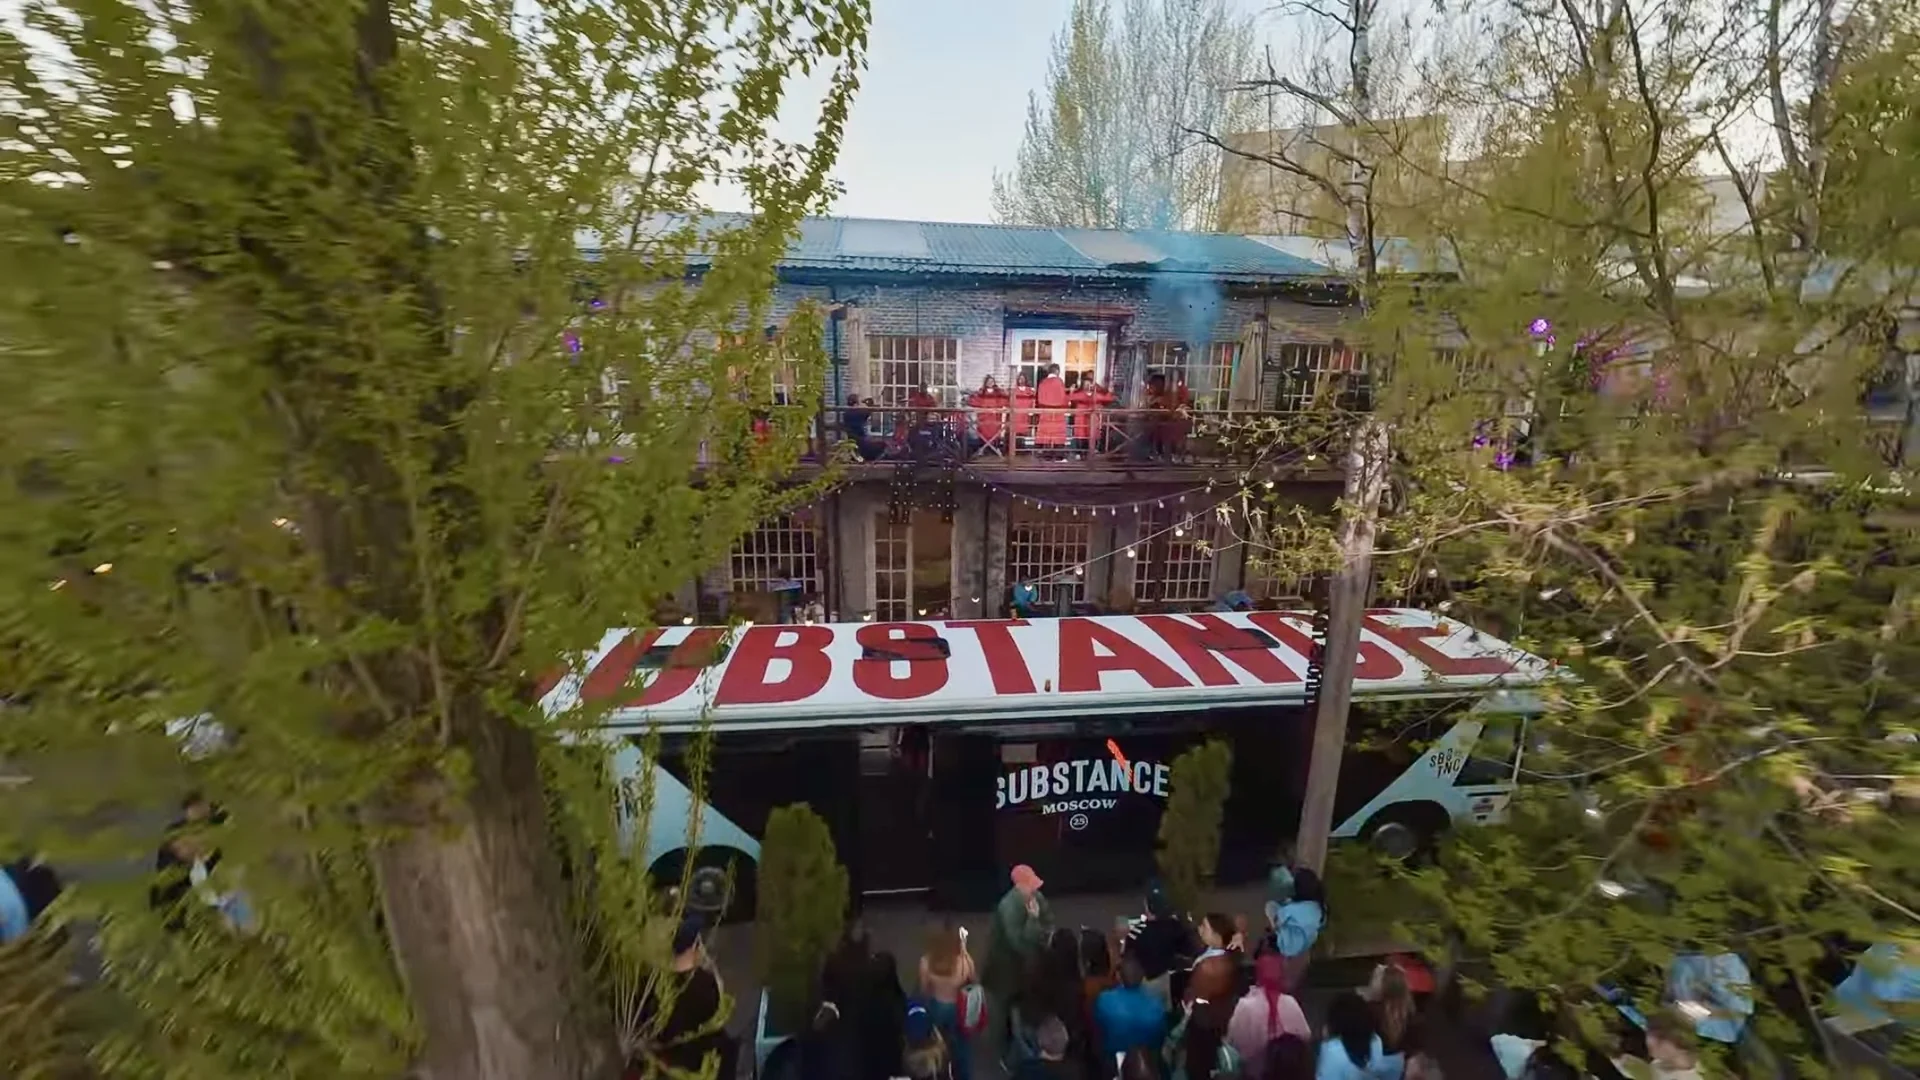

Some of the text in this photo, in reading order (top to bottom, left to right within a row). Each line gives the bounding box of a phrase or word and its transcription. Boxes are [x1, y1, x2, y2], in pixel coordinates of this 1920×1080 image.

[535, 608, 1519, 708] UBSTANCE
[996, 759, 1170, 809] SUBSTANCE
[1042, 799, 1117, 815] MOSCOW
